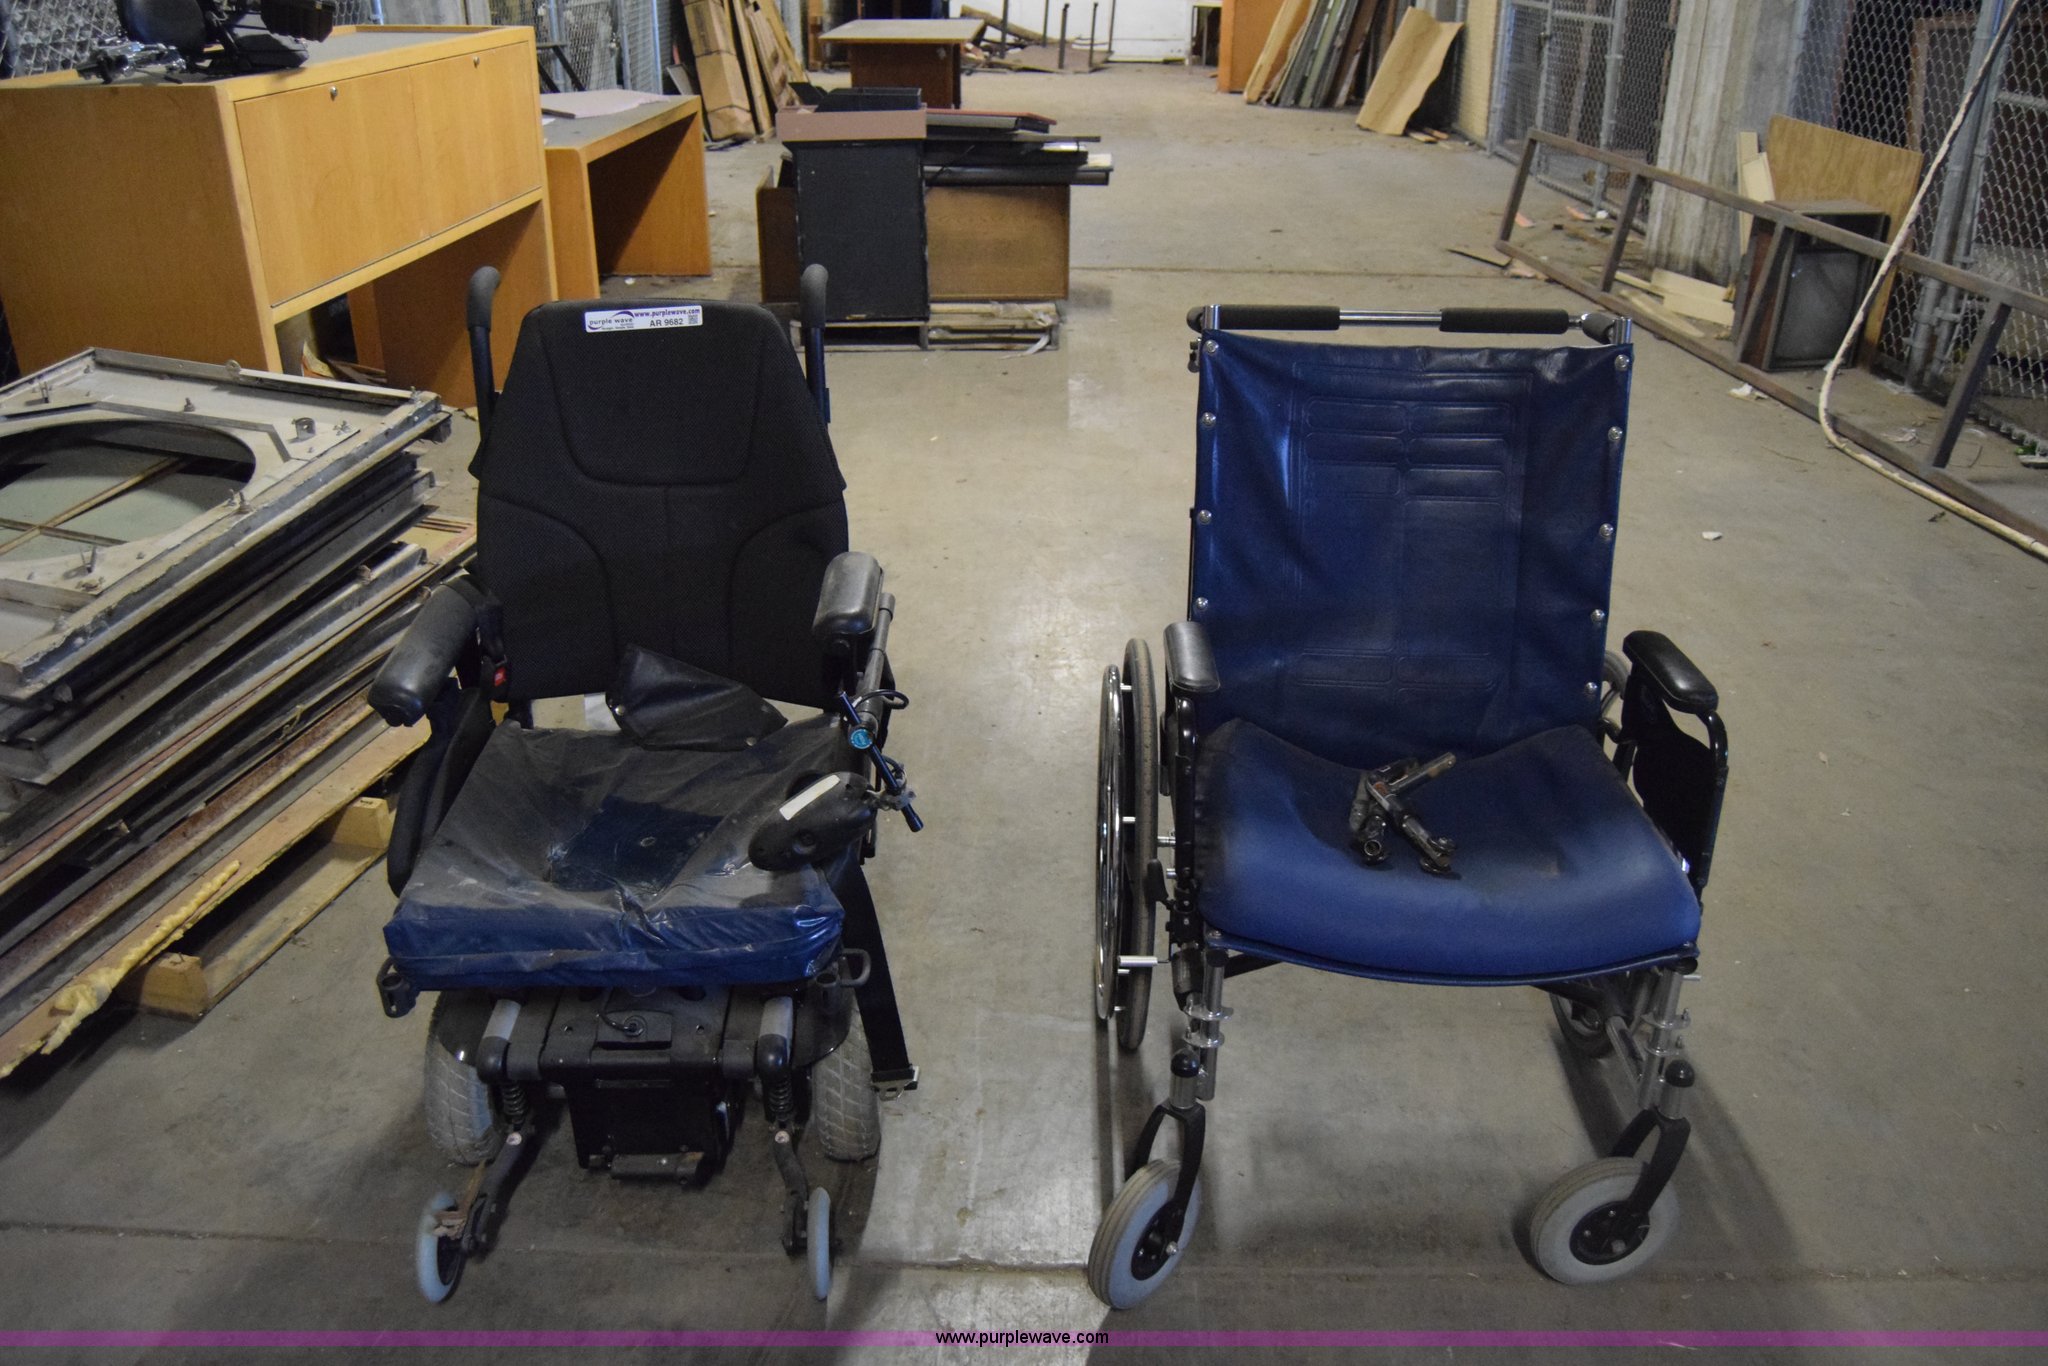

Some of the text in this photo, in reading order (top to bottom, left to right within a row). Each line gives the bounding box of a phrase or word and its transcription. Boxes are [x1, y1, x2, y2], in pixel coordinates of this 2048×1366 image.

[634, 308, 700, 318] www.purplewave.com
[650, 318, 684, 327] AR 9682
